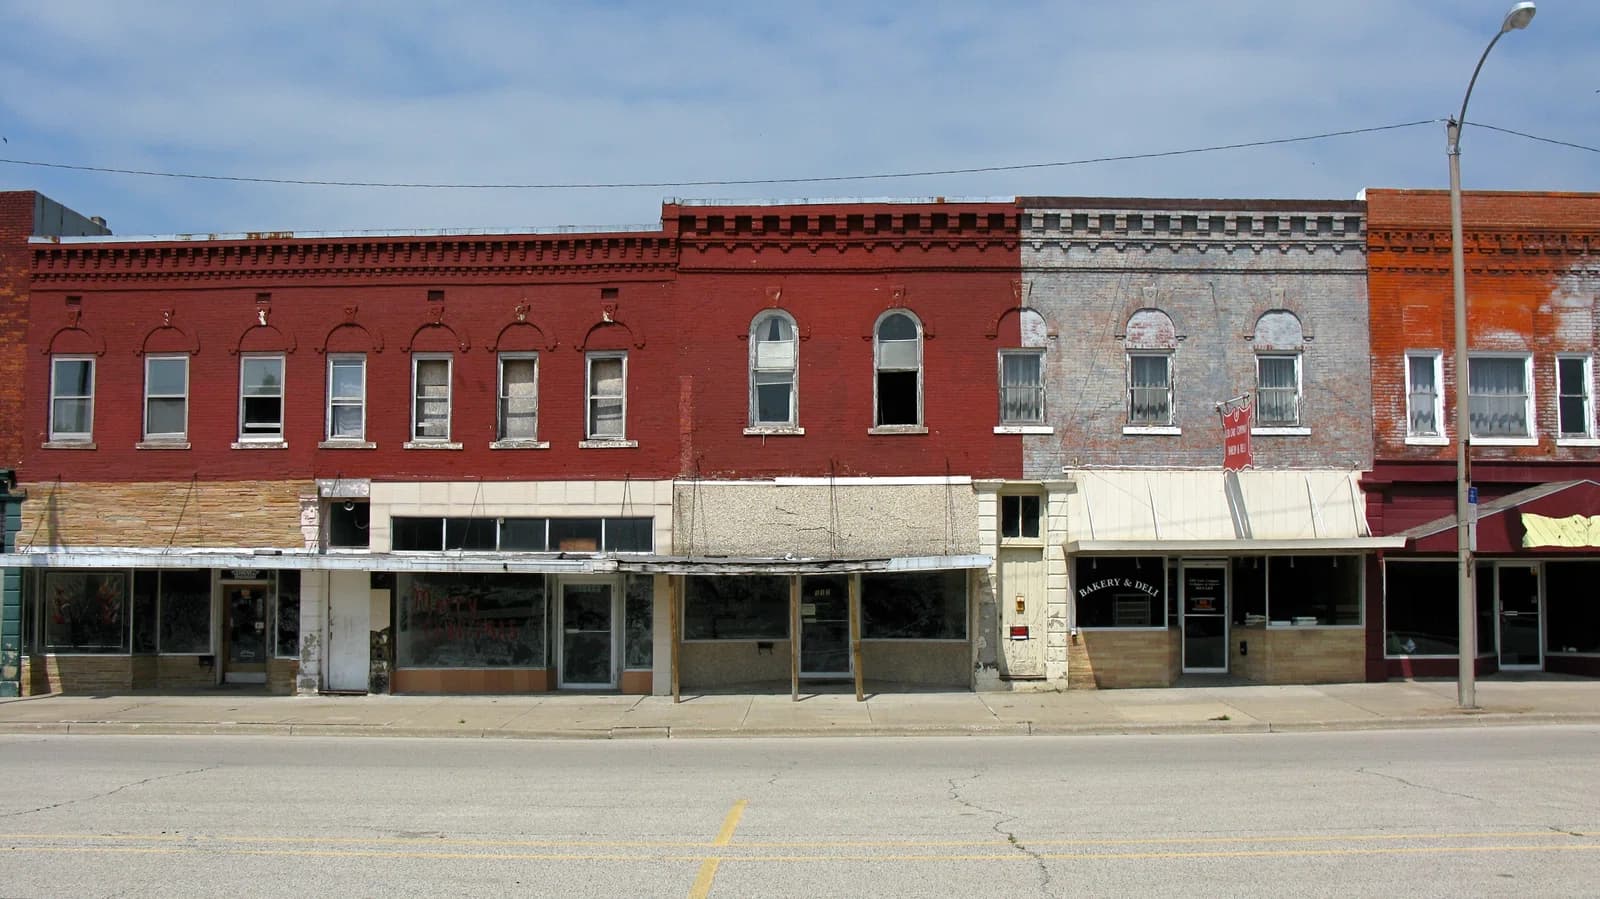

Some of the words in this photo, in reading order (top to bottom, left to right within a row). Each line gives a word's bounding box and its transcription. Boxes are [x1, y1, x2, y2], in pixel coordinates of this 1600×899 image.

[1078, 578, 1121, 598] BAKERY
[1123, 578, 1133, 588] &
[1134, 580, 1160, 598] DELI
